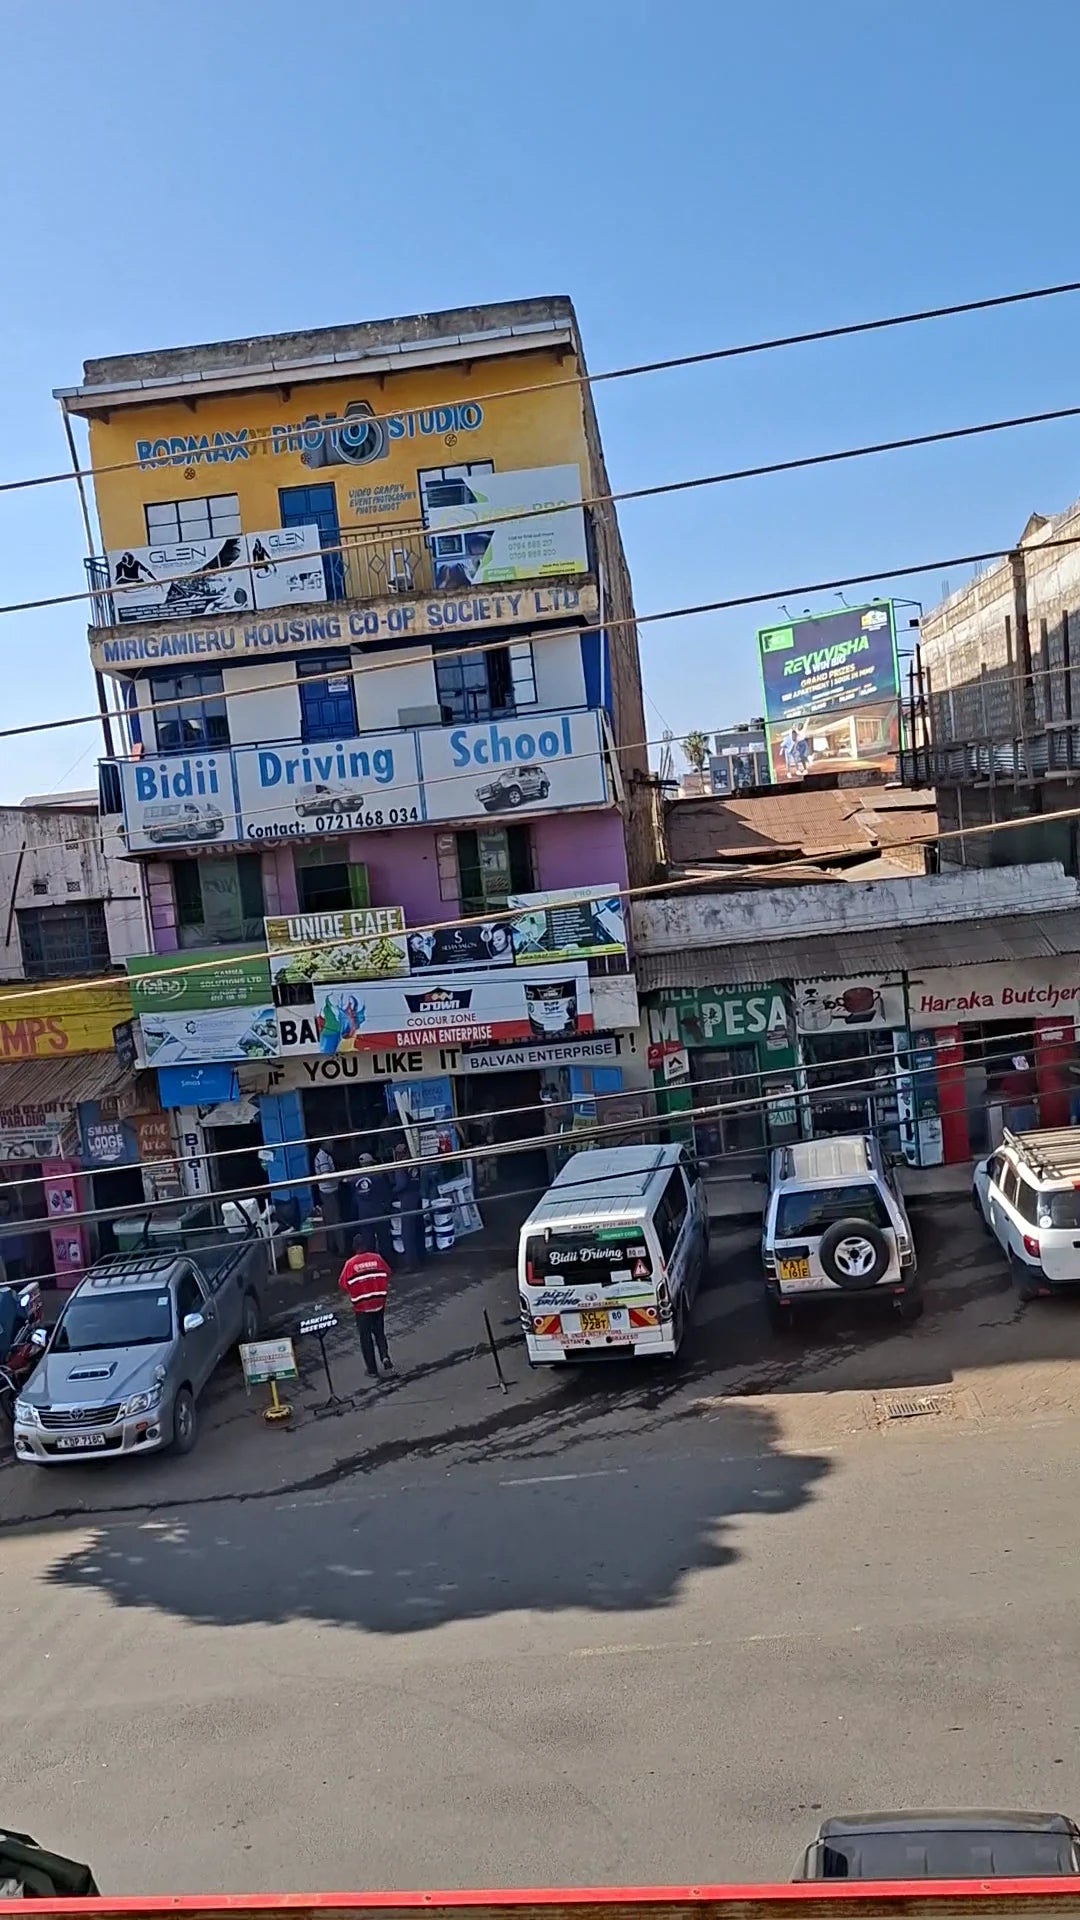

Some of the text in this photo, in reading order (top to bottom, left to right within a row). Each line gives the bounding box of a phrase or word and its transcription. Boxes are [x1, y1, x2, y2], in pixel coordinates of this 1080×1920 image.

[136, 428, 250, 471] RODMAX
[386, 401, 483, 440] STUDIO
[268, 531, 305, 548] GLEN
[149, 546, 207, 564] GLEN
[243, 616, 341, 647] HOUSING
[349, 606, 416, 635] CO-OP
[427, 594, 522, 626] SOCIETY
[534, 588, 579, 613] LTD
[801, 672, 828, 688] GRAND
[135, 717, 573, 802] Bidii Driving School
[247, 820, 306, 839] Contact:
[389, 807, 419, 823] 034
[287, 909, 398, 942] UNIQE CAFE
[920, 991, 994, 1013] Haraka
[407, 1012, 477, 1027] COLOUR ZONE
[701, 996, 788, 1038] PESA
[0, 1016, 69, 1057] MPS
[280, 1018, 321, 1046] BA
[396, 1025, 493, 1047] BALVAN ENTERPRISE
[303, 1056, 359, 1082] YOU
[373, 1051, 423, 1074] LIKE
[439, 1049, 461, 1070] IT
[470, 1042, 613, 1069] BALVAN ENTERPRISE
[0, 1113, 46, 1128] PARLOUR
[87, 1124, 120, 1136] SMART
[87, 1134, 125, 1152] LODGE
[549, 1247, 623, 1266] Bidii Driving
[300, 1312, 334, 1328] PARKING
[300, 1318, 338, 1334] RESERVED
[581, 1312, 600, 1321] KCL
